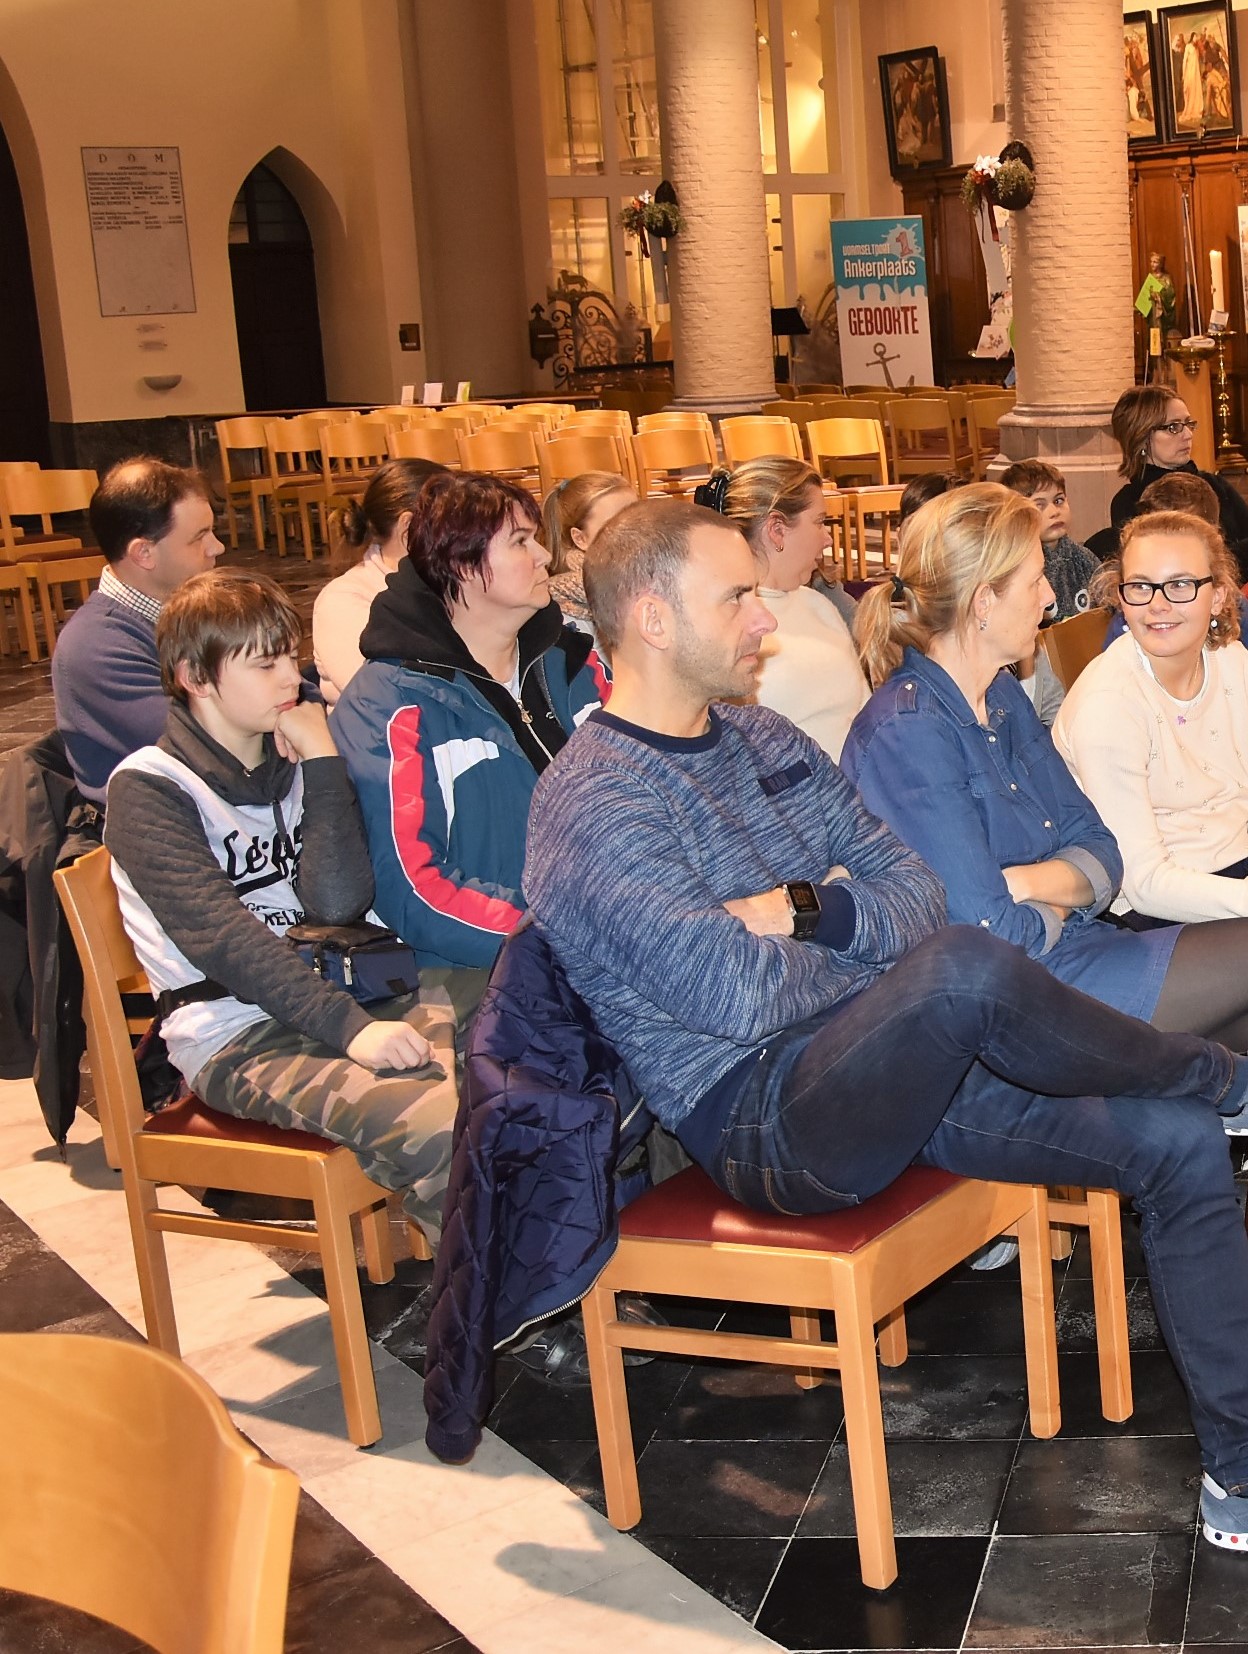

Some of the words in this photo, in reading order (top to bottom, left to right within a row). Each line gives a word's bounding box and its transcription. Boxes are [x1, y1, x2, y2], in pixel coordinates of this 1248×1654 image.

[155, 154, 164, 163] M
[895, 231, 914, 257] 1
[844, 258, 916, 280] Ankerplaats
[848, 305, 919, 336] GEBOORTE
